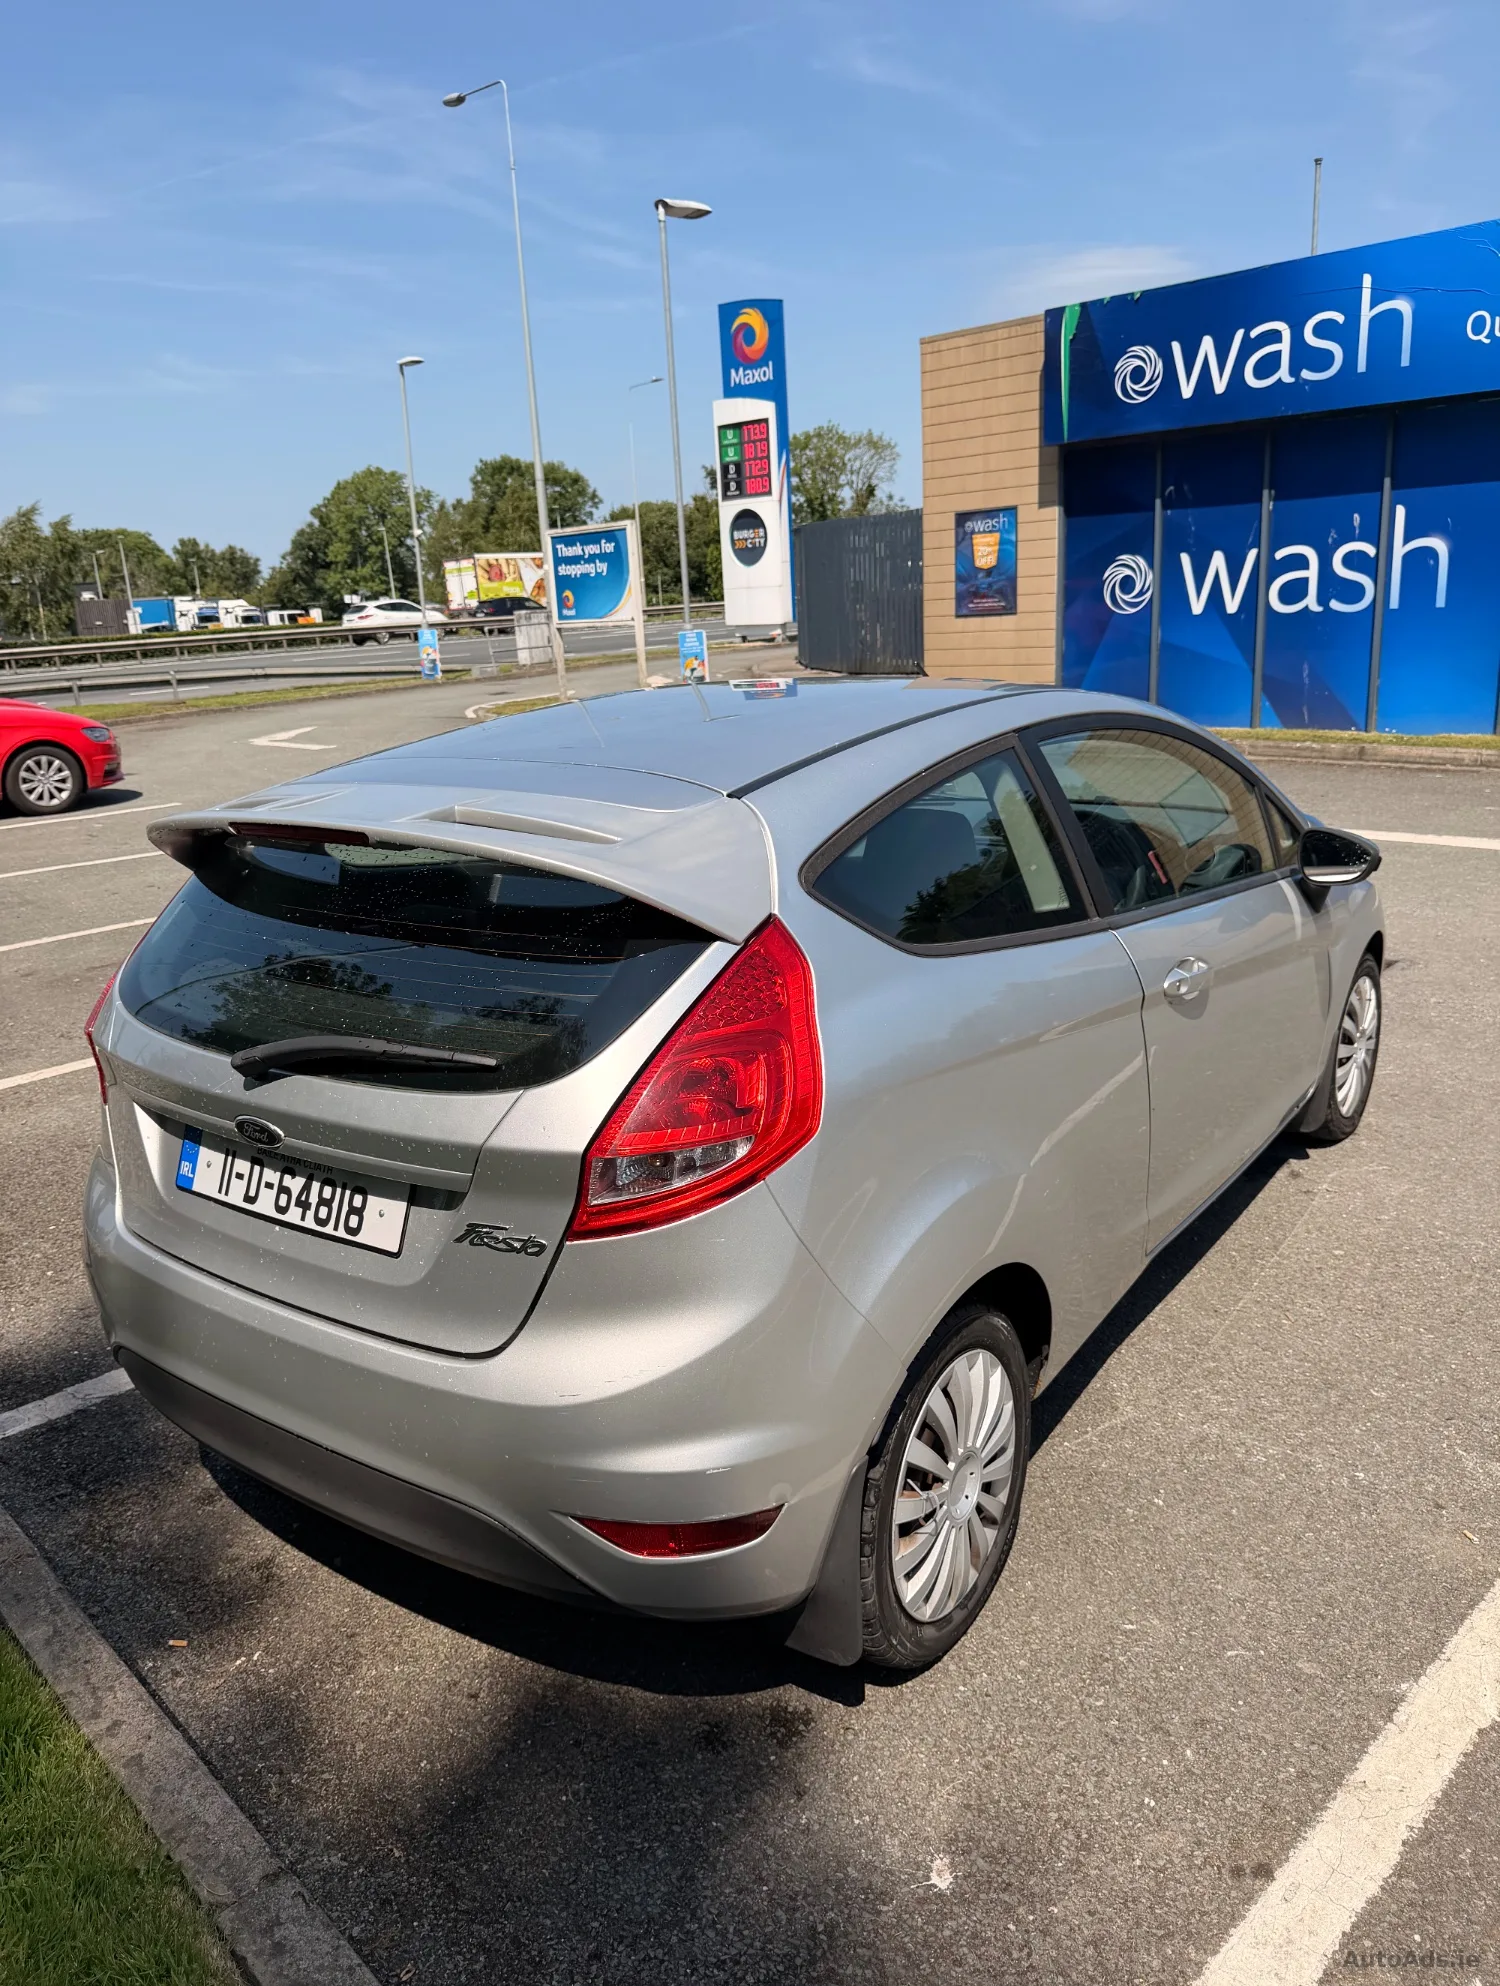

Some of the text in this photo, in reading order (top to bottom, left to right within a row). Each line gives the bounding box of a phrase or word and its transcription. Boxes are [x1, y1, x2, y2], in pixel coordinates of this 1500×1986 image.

[1171, 273, 1414, 399] wash
[731, 360, 774, 387] Maxol
[972, 513, 1008, 532] wash
[733, 527, 765, 540] BURGER
[556, 539, 615, 558] Thank you for
[558, 559, 608, 578] stopping by
[1179, 504, 1450, 616] wash
[243, 1122, 269, 1142] Ford
[179, 1160, 194, 1178] IRL
[218, 1148, 368, 1237] 11-D-64818
[453, 1222, 547, 1257] Fiesta
